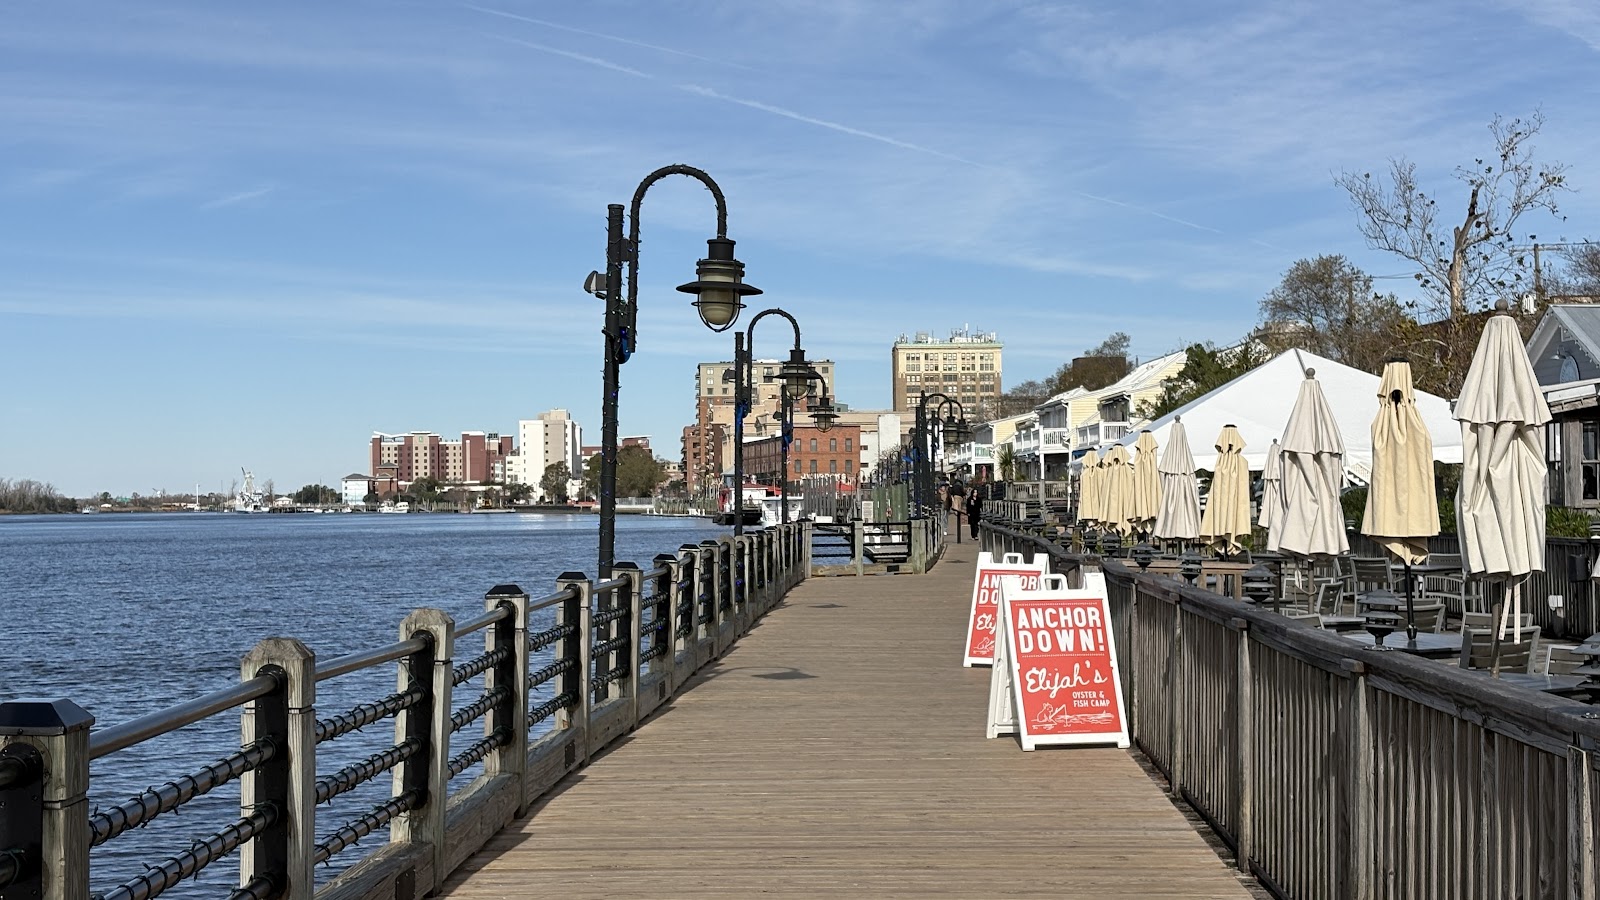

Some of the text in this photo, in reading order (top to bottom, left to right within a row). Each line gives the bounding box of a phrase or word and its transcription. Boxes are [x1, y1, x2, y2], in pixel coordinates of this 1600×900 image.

[981, 574, 1037, 590] ANOR
[1017, 606, 1102, 629] ANCHOR
[1018, 628, 1105, 654] DOWN!
[1025, 659, 1108, 699] Elijah's
[1072, 690, 1105, 699] OYSTER &
[1073, 699, 1110, 708] FISH CAMP
